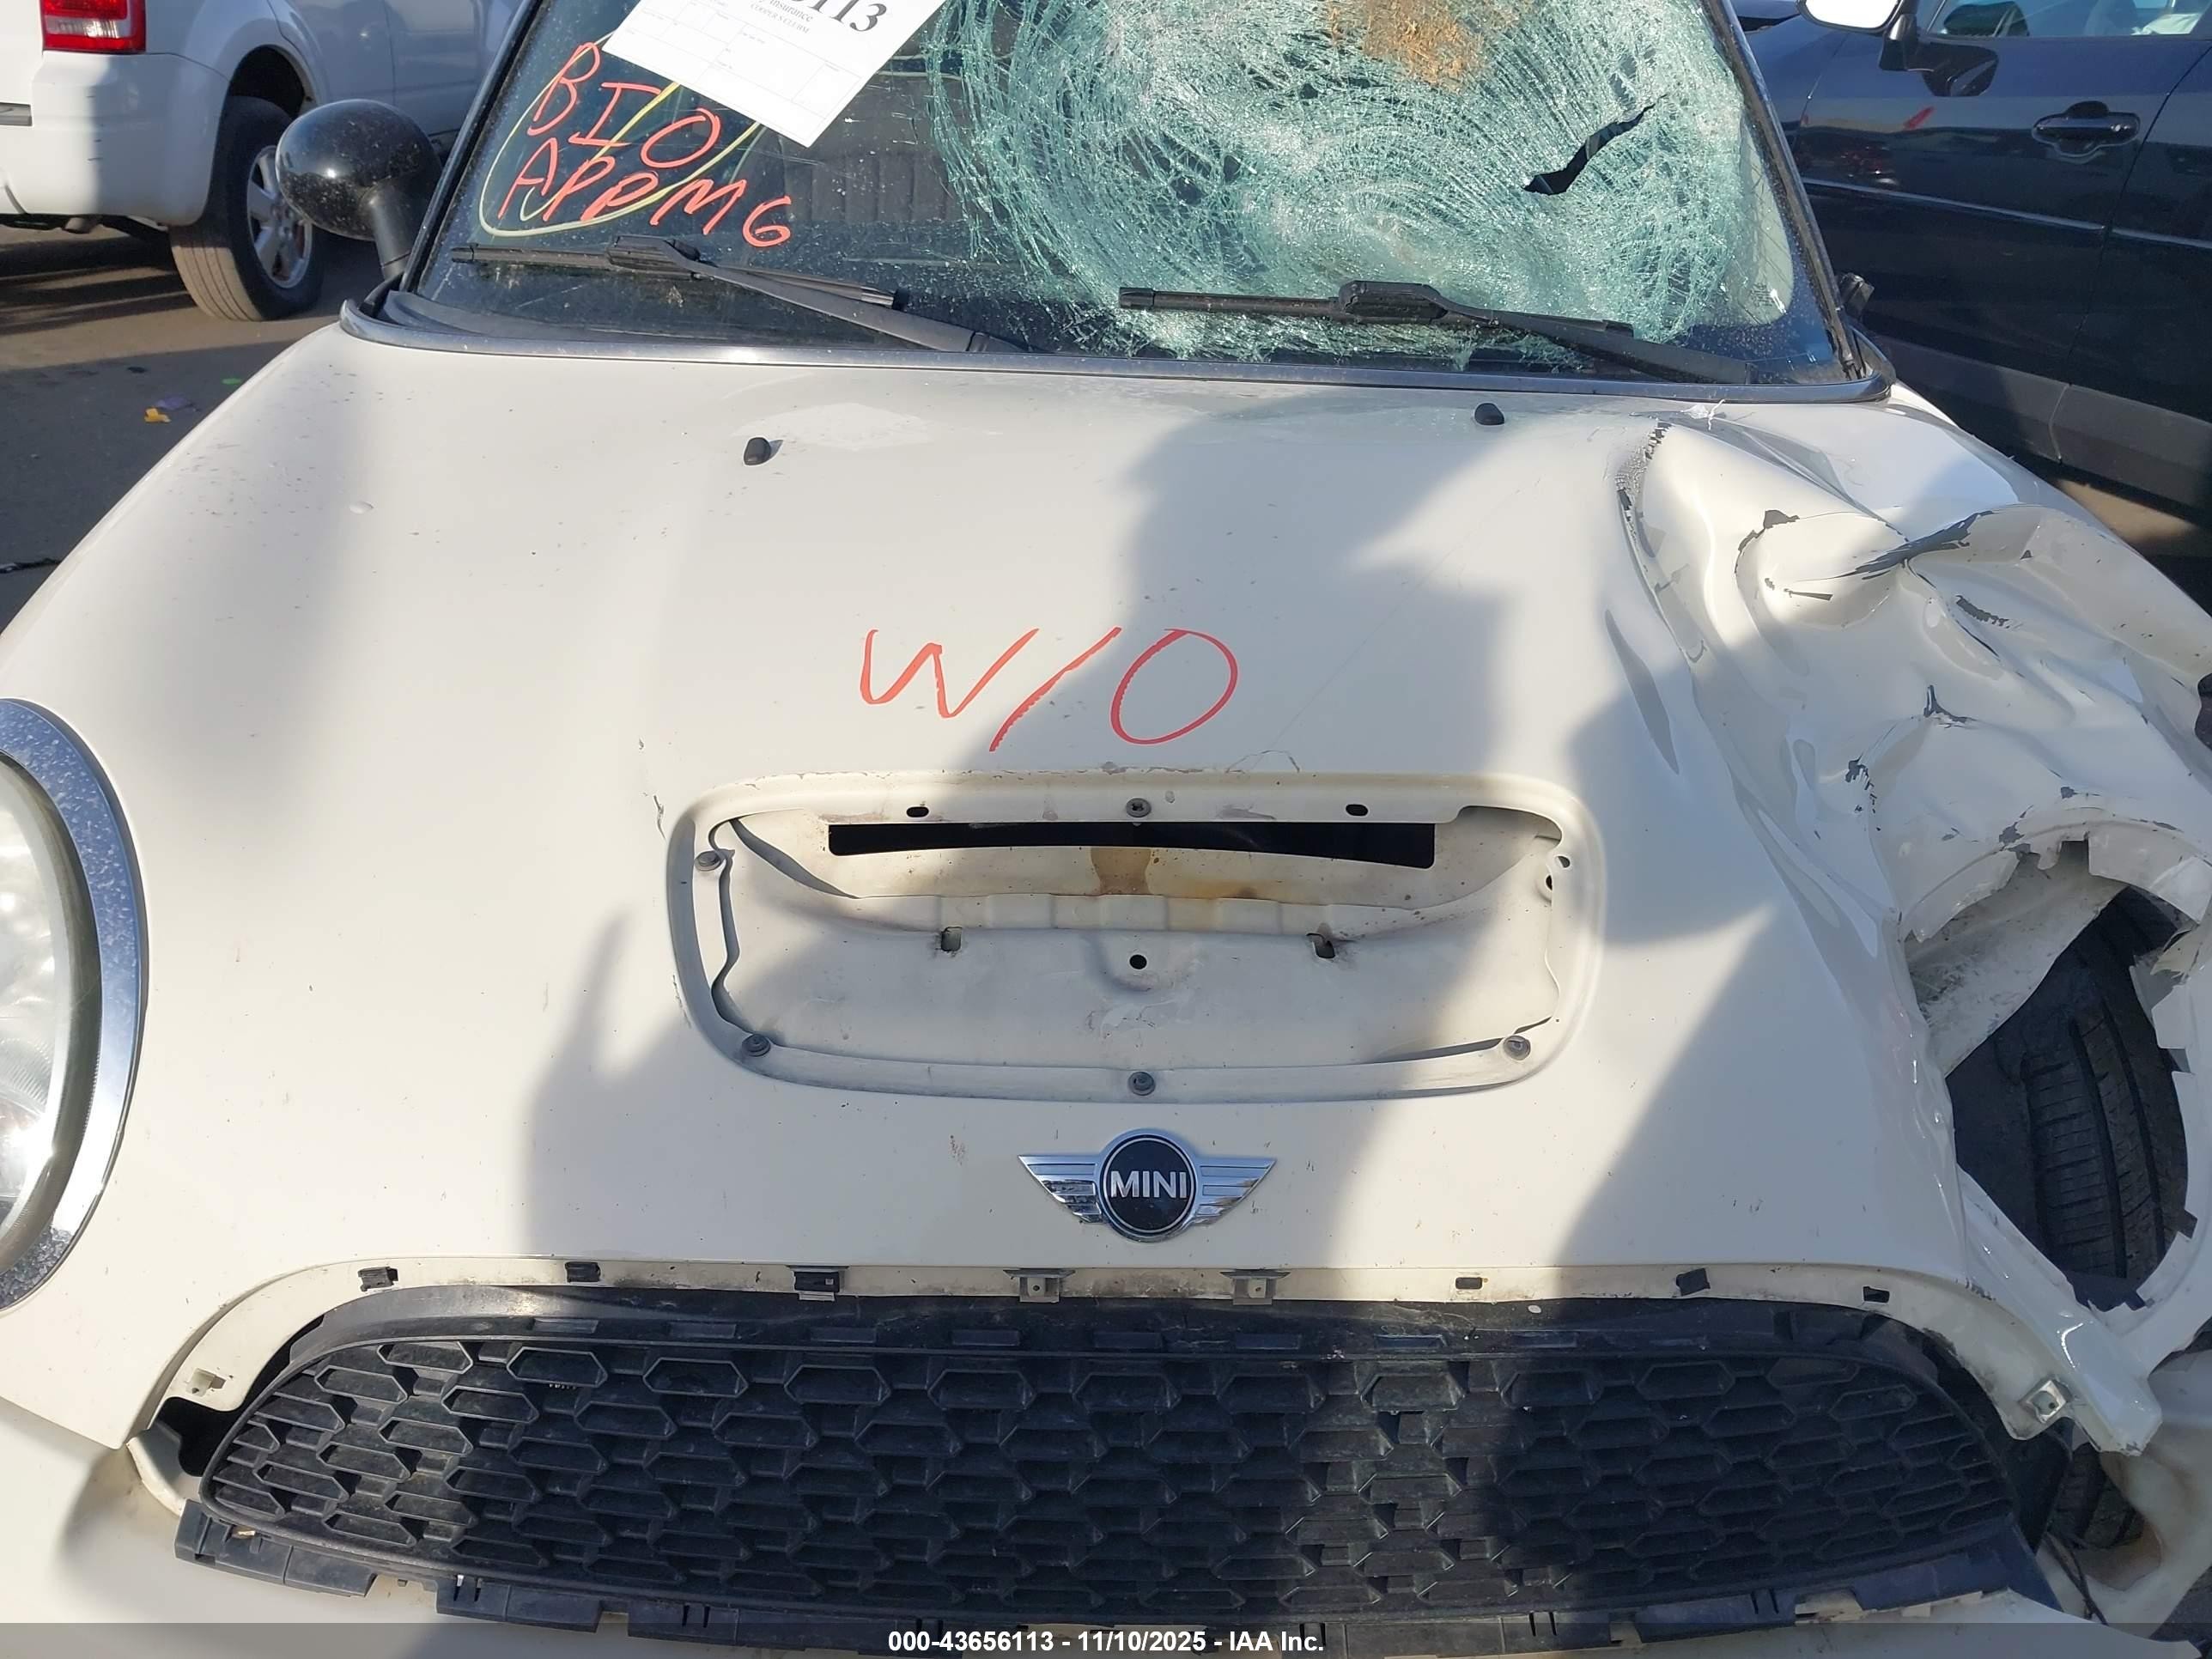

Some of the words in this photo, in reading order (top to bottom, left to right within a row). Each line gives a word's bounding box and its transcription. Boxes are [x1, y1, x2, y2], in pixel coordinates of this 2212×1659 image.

[527, 42, 721, 168] BIO
[860, 626, 1238, 752] W/O
[1110, 1170, 1188, 1199] MINI
